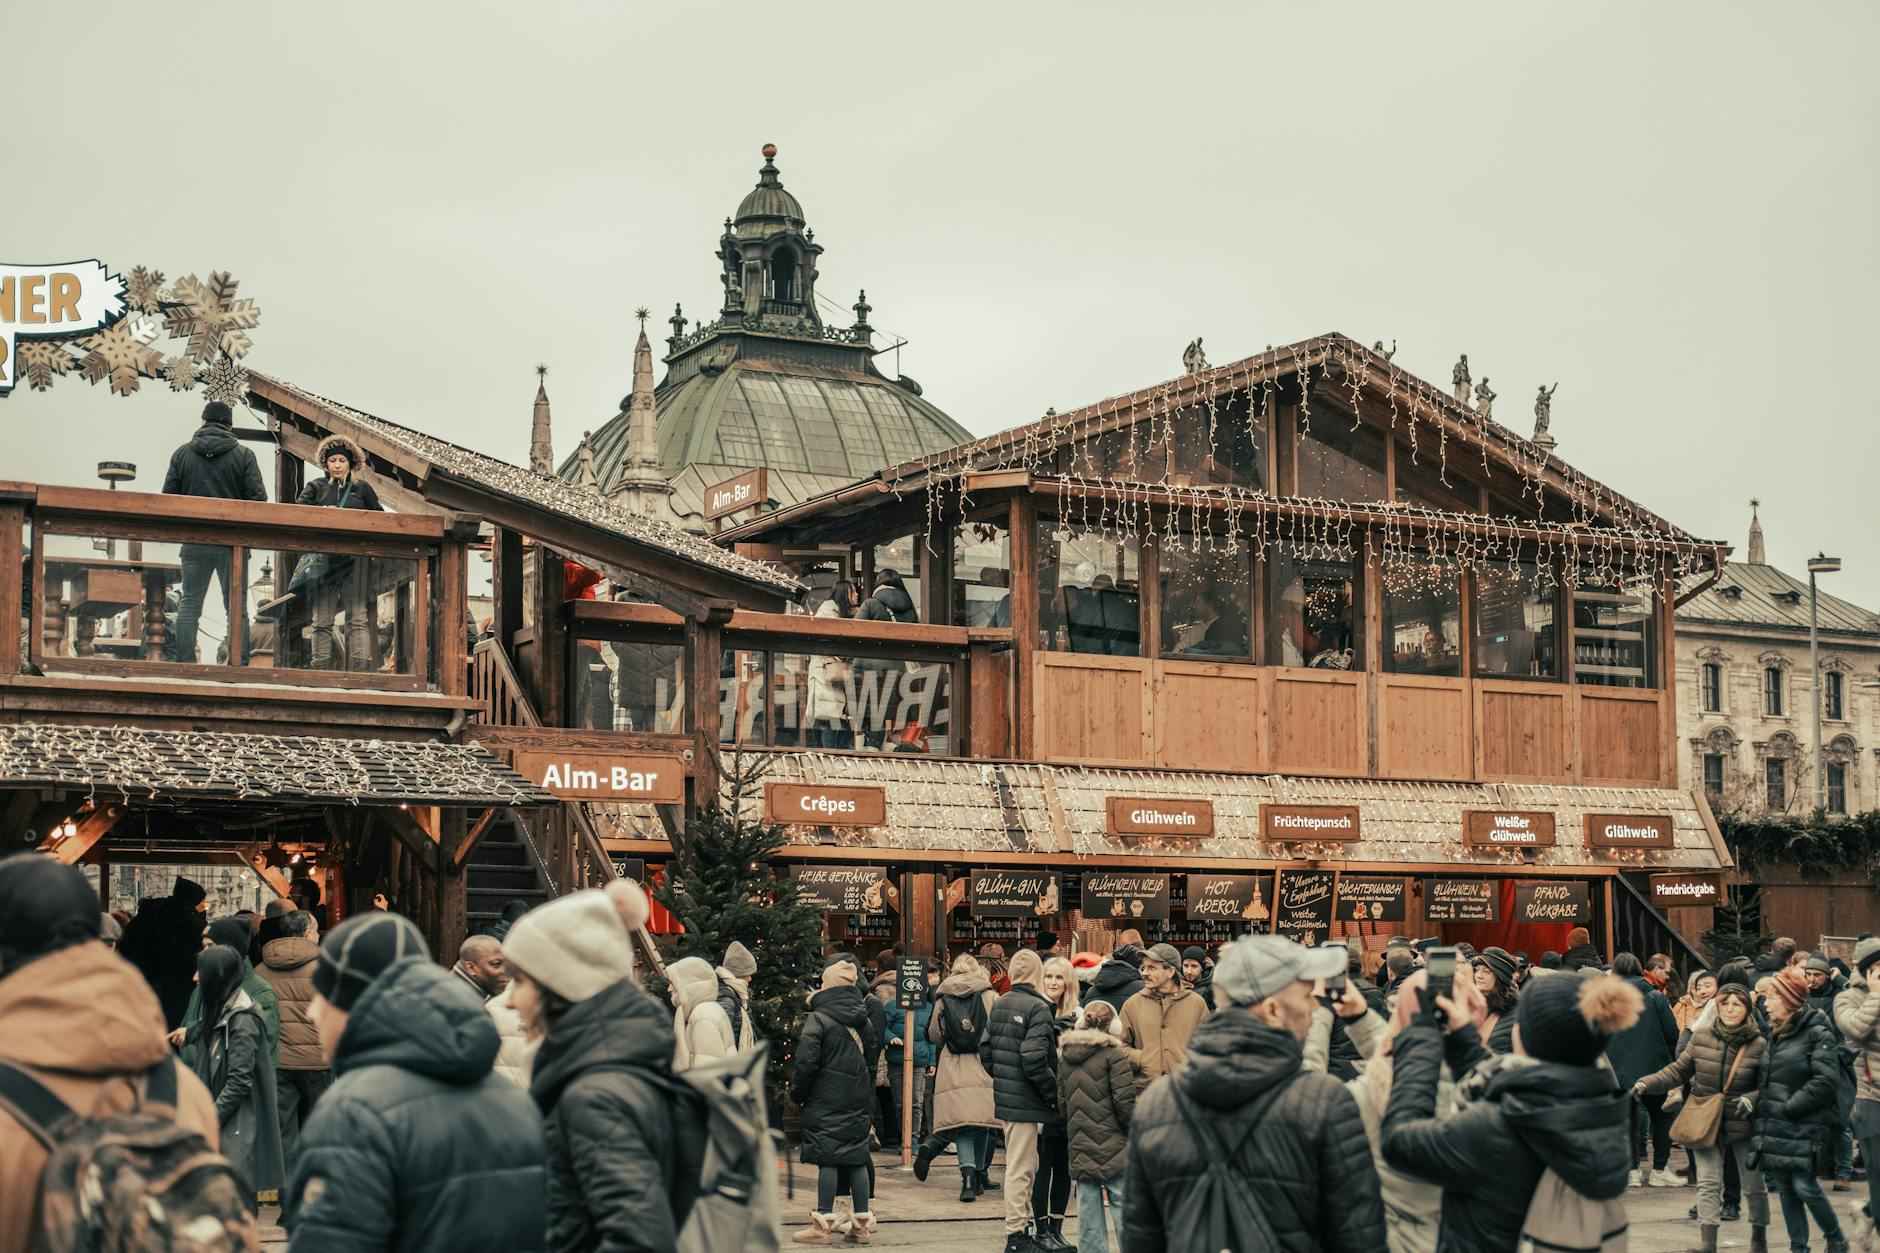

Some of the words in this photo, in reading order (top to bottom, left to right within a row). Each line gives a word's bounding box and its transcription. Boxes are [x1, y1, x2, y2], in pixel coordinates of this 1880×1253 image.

[712, 484, 751, 511] Alm-Bar
[542, 762, 658, 792] Alm-Bar
[800, 795, 857, 816] Crêpes
[1131, 809, 1196, 825] Glühwein
[1274, 815, 1352, 831] Früchtepunsch
[1494, 815, 1531, 828] Weißer
[1490, 829, 1537, 841] Glühwein
[1604, 824, 1659, 839] Glühwein
[829, 869, 878, 885] GETRÄNKE
[975, 873, 1043, 896] GLÜH-GIN
[1087, 875, 1140, 892] GLÜHWEIN
[1204, 880, 1234, 896] HOT
[1337, 880, 1403, 895] RÜCHTEPUNSCH
[1433, 881, 1480, 896] GLÜHWEIN
[1534, 886, 1571, 900] PFAND-
[1656, 882, 1716, 898] Pfandrückgabe
[1194, 898, 1240, 916] APEROL
[1526, 900, 1578, 919] RÜCKGABE
